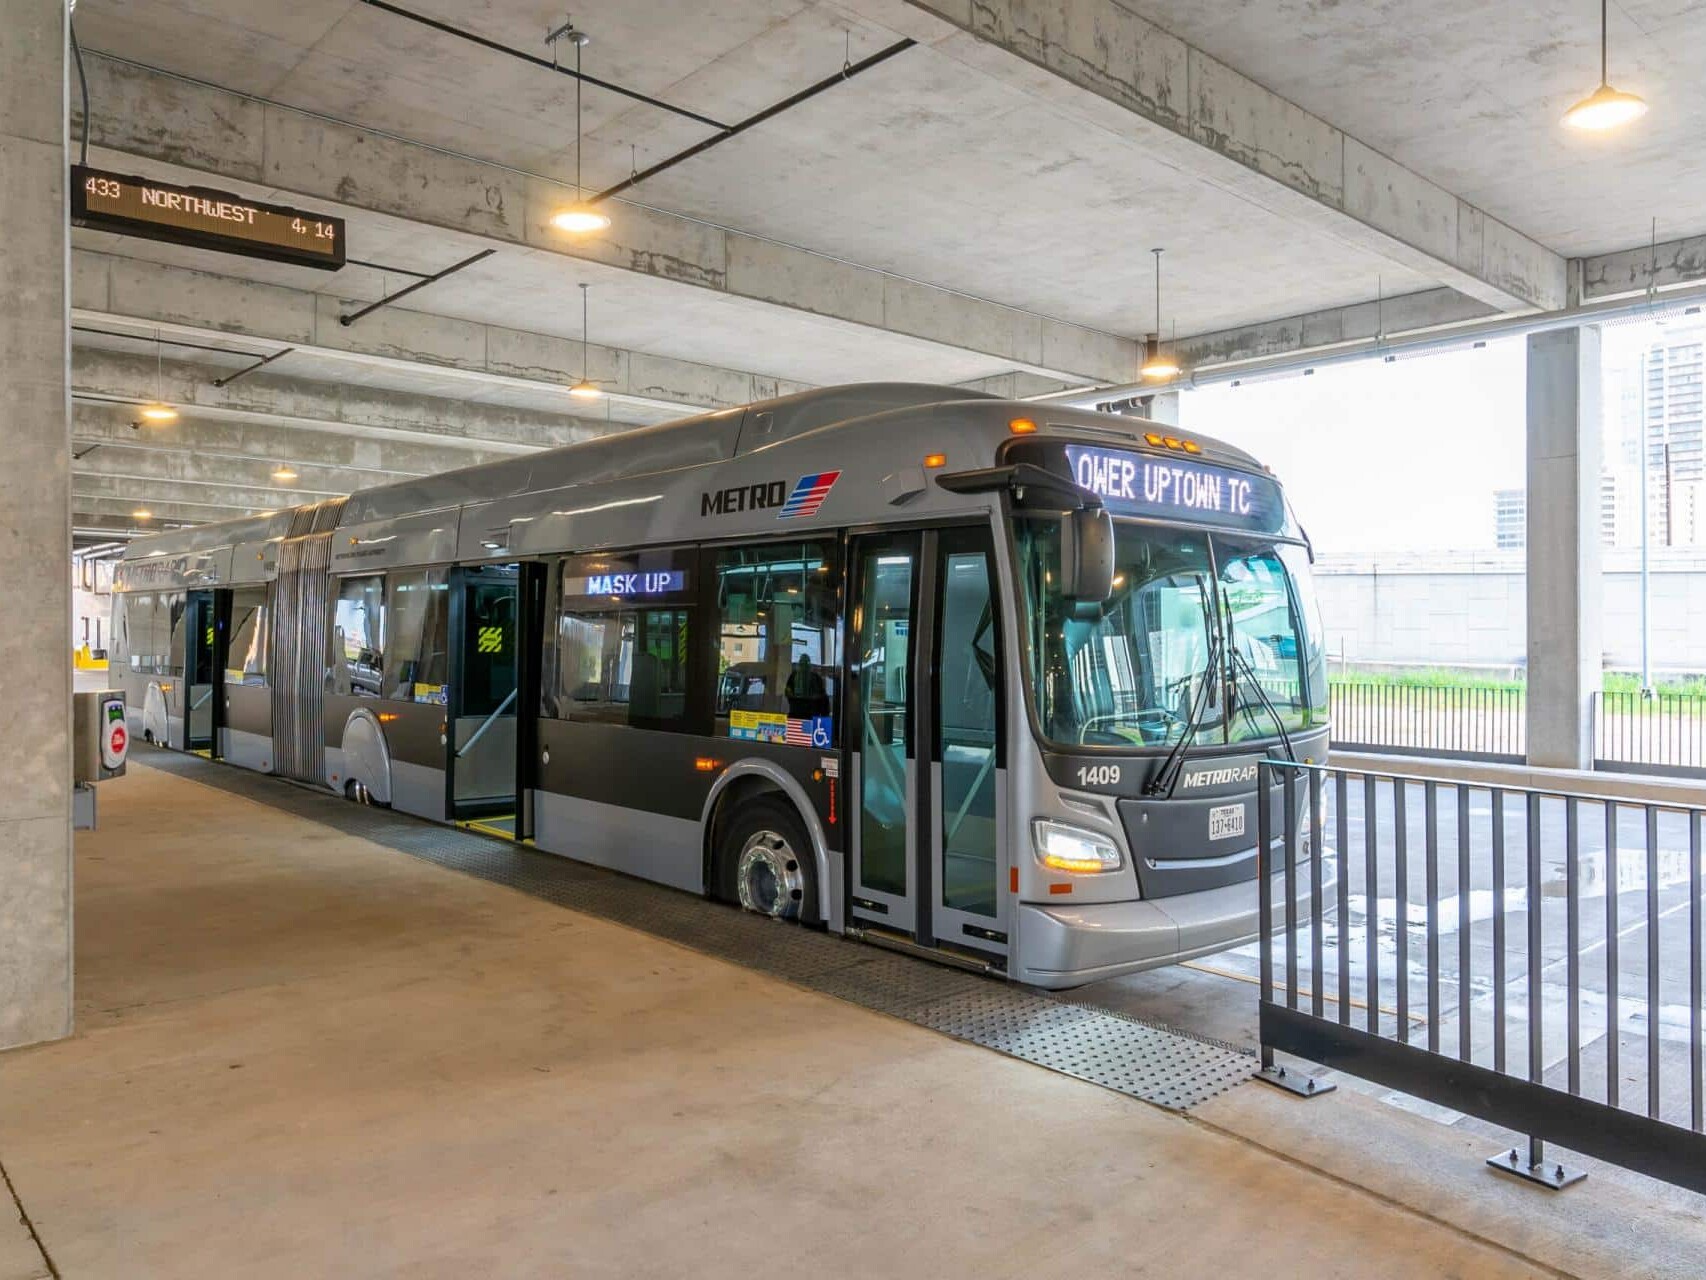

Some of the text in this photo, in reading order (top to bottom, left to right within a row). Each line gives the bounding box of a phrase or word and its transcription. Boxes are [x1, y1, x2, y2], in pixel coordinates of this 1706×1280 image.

[85, 176, 121, 199] 433
[141, 186, 258, 225] NORTHWEST
[315, 222, 335, 240] 14
[701, 480, 786, 517] METRO
[1144, 463, 1221, 512] UPTOWN
[1228, 478, 1251, 515] TC
[588, 573, 671, 595] MASK UP
[1077, 765, 1121, 786] 1409
